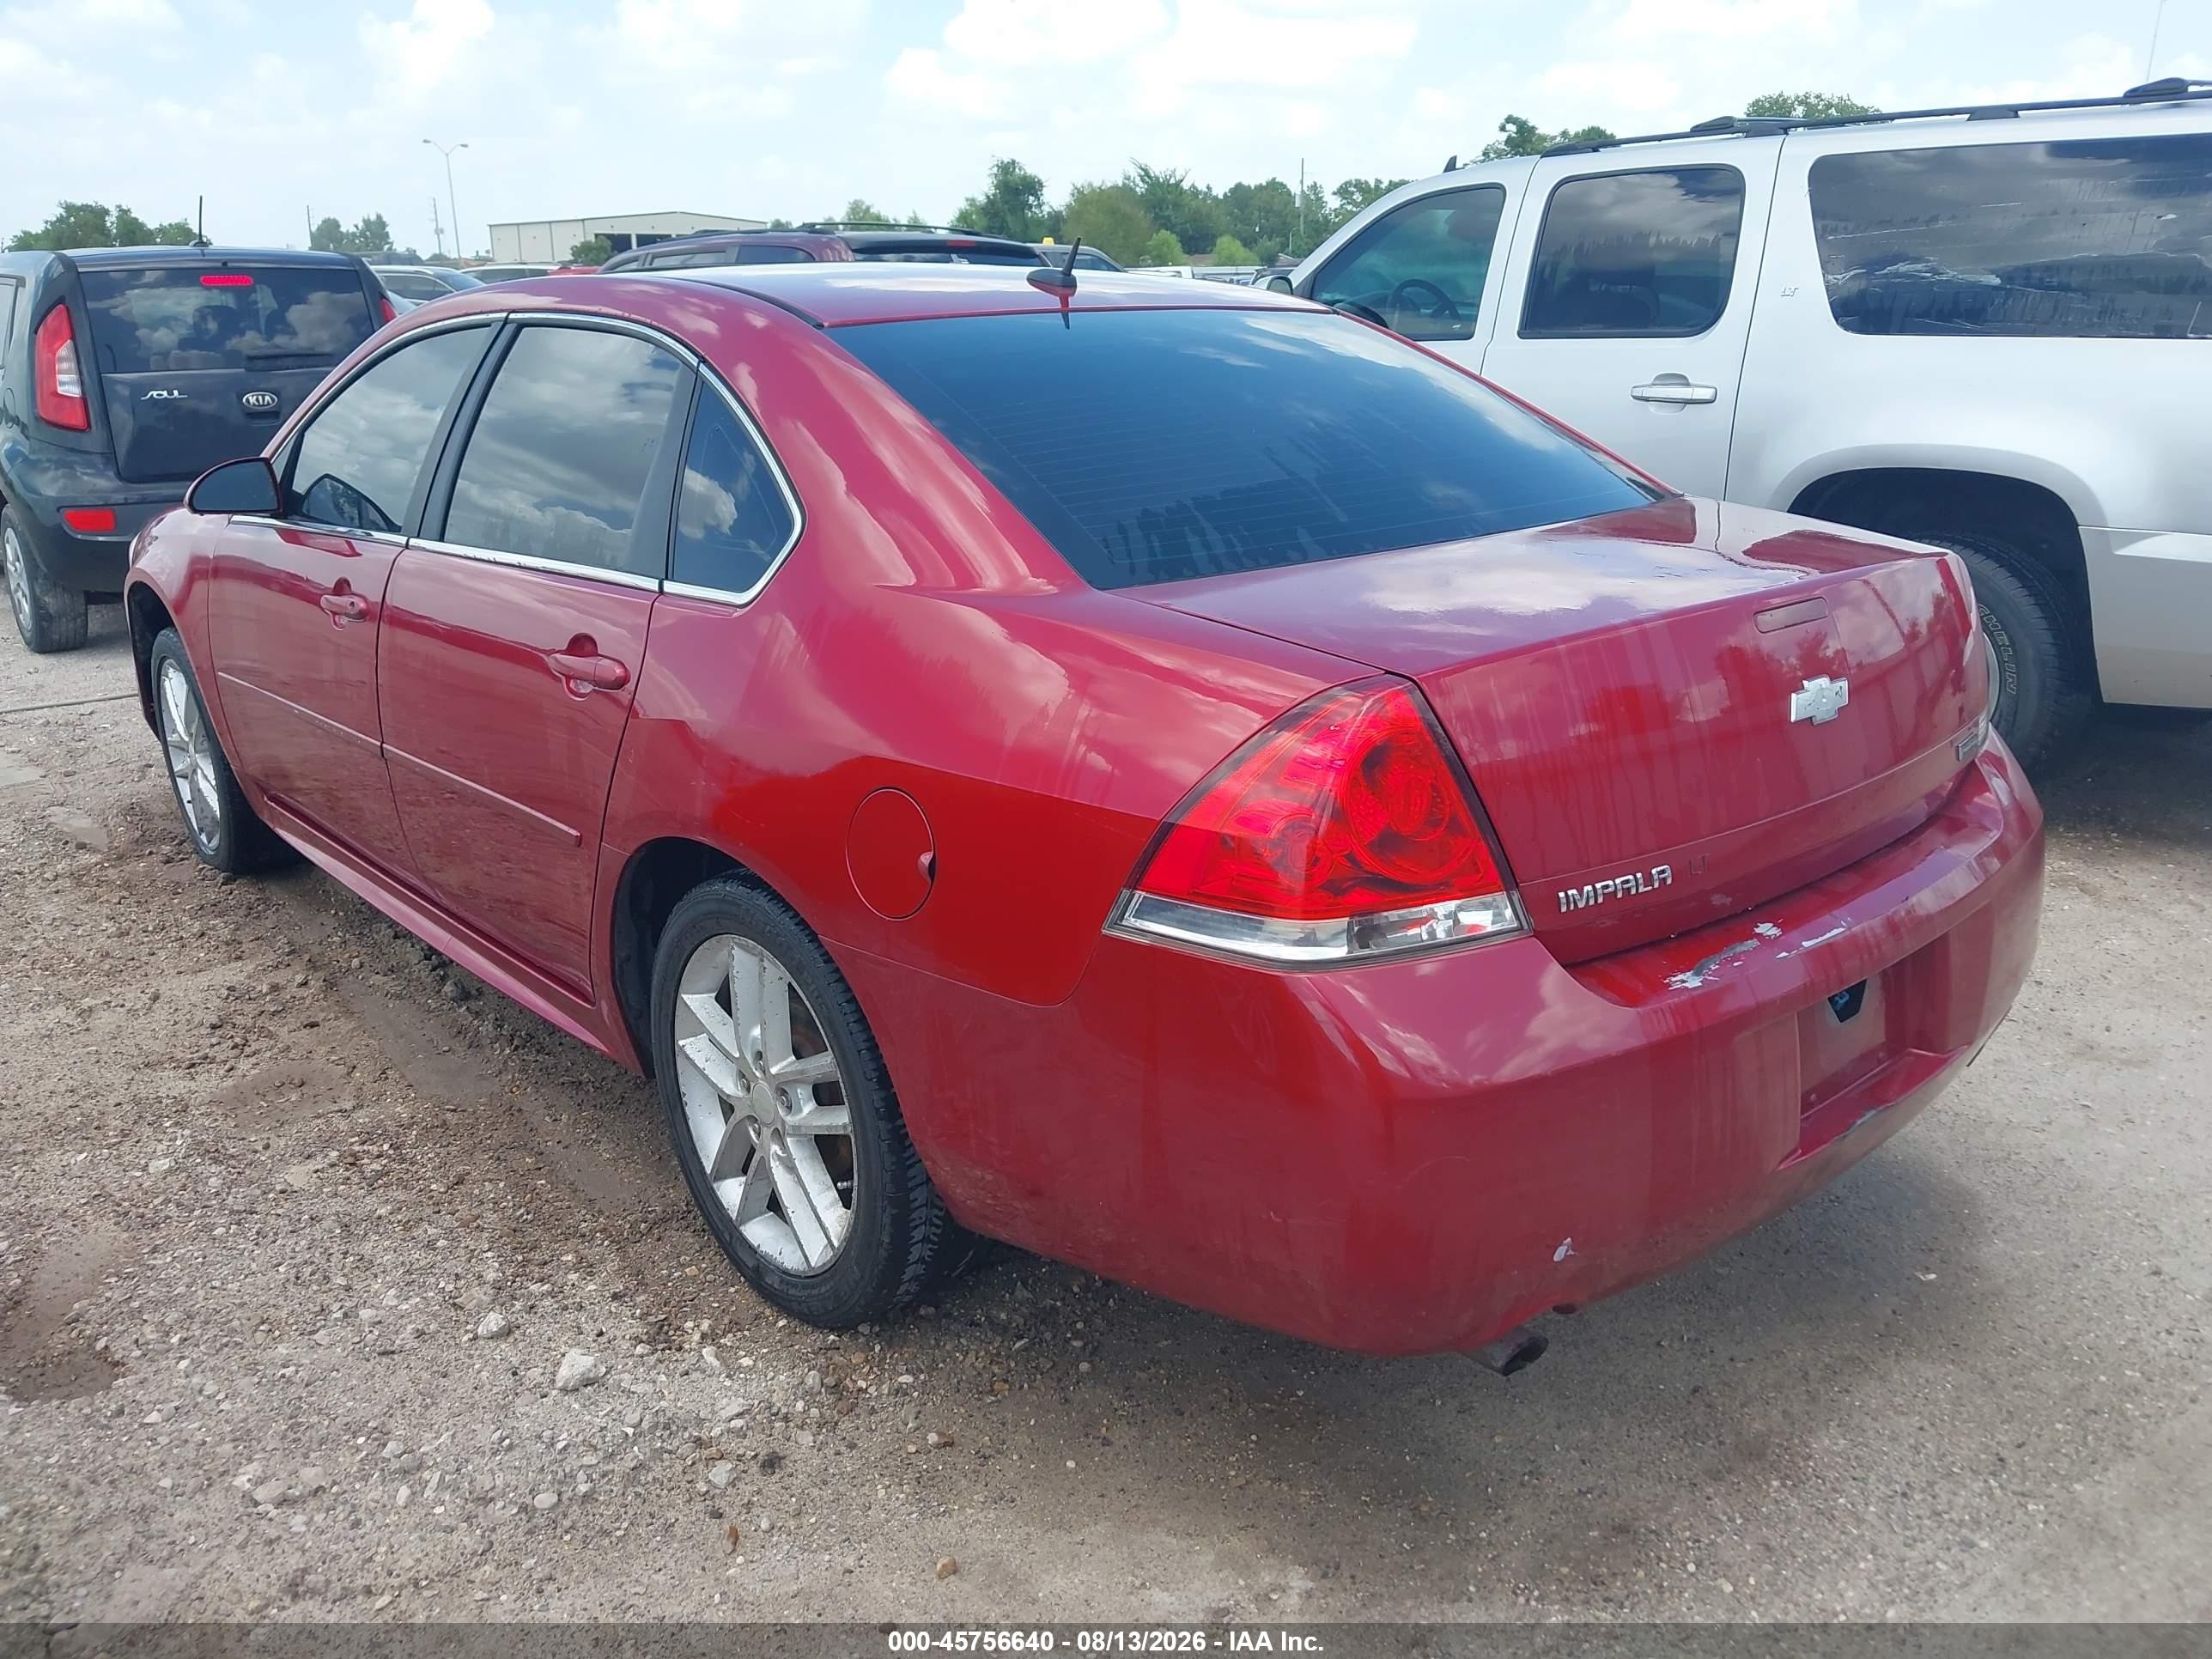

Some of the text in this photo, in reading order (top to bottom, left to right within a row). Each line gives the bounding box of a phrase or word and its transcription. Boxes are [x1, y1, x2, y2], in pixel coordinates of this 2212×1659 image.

[140, 389, 188, 400] SOUL
[247, 394, 273, 406] KIA
[1978, 604, 2018, 695] CHELIN
[1557, 865, 1673, 914] IMPALA
